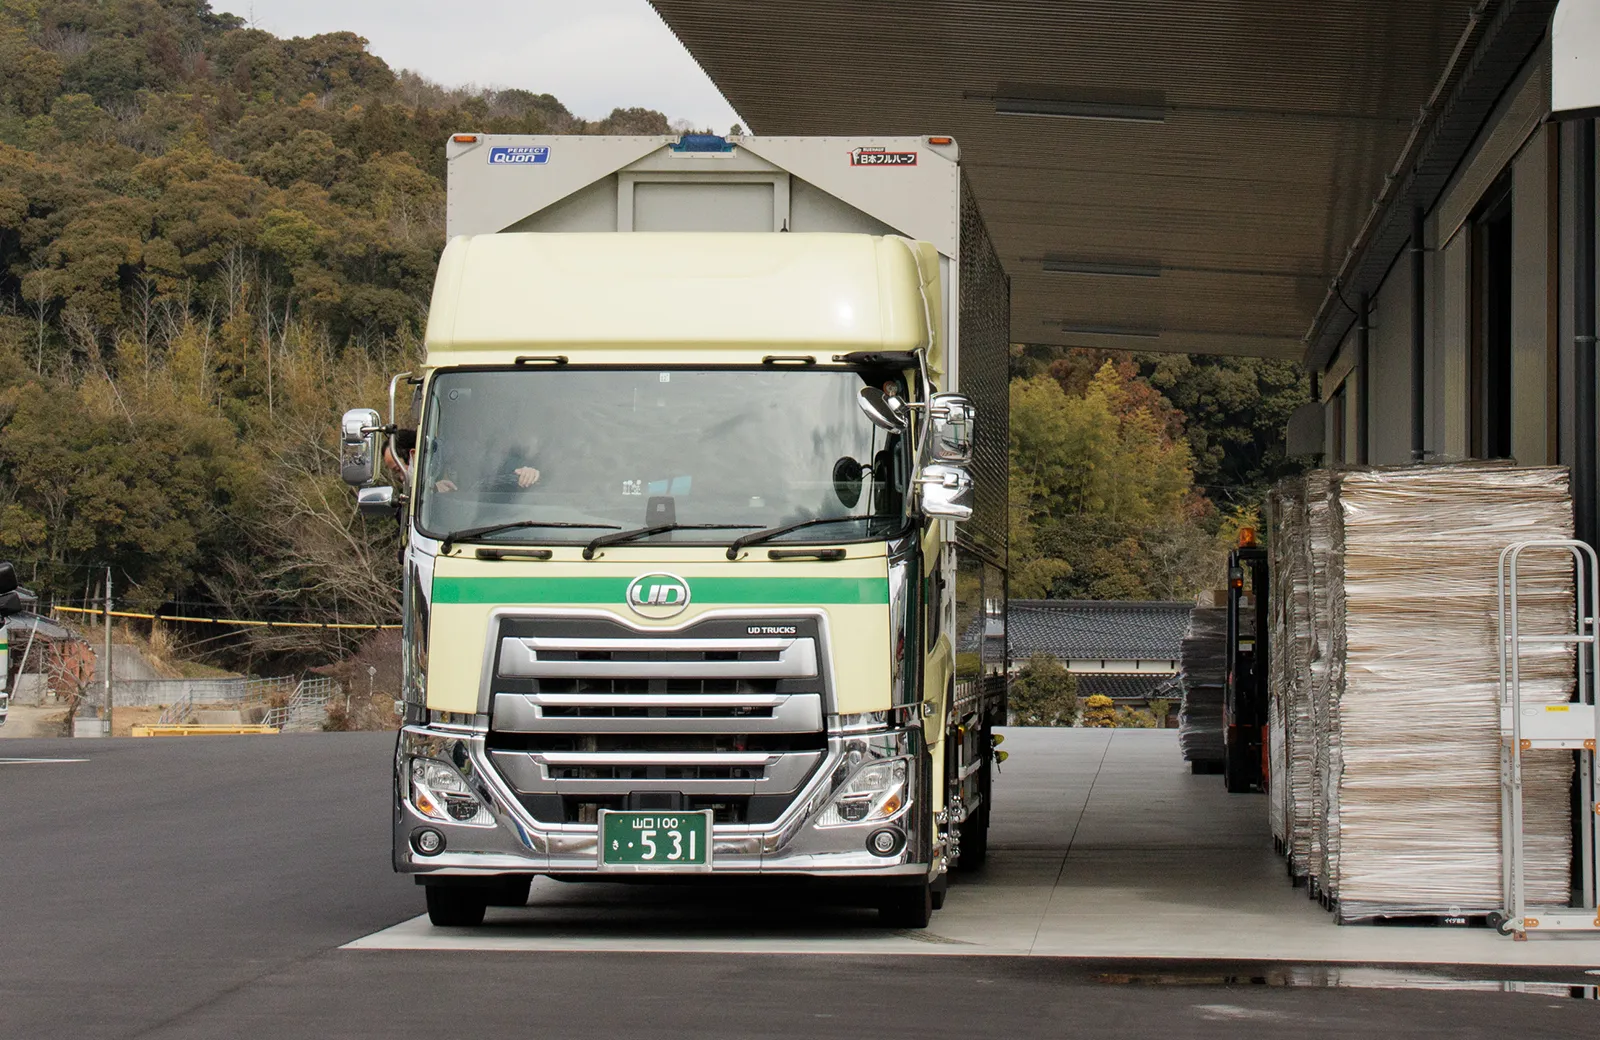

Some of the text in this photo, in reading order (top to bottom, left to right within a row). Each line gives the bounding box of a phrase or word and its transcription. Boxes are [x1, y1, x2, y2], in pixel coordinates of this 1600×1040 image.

[860, 154, 915, 164] 日本フルハーフ
[631, 584, 686, 606] UD
[747, 626, 796, 634] UD TRUCKS
